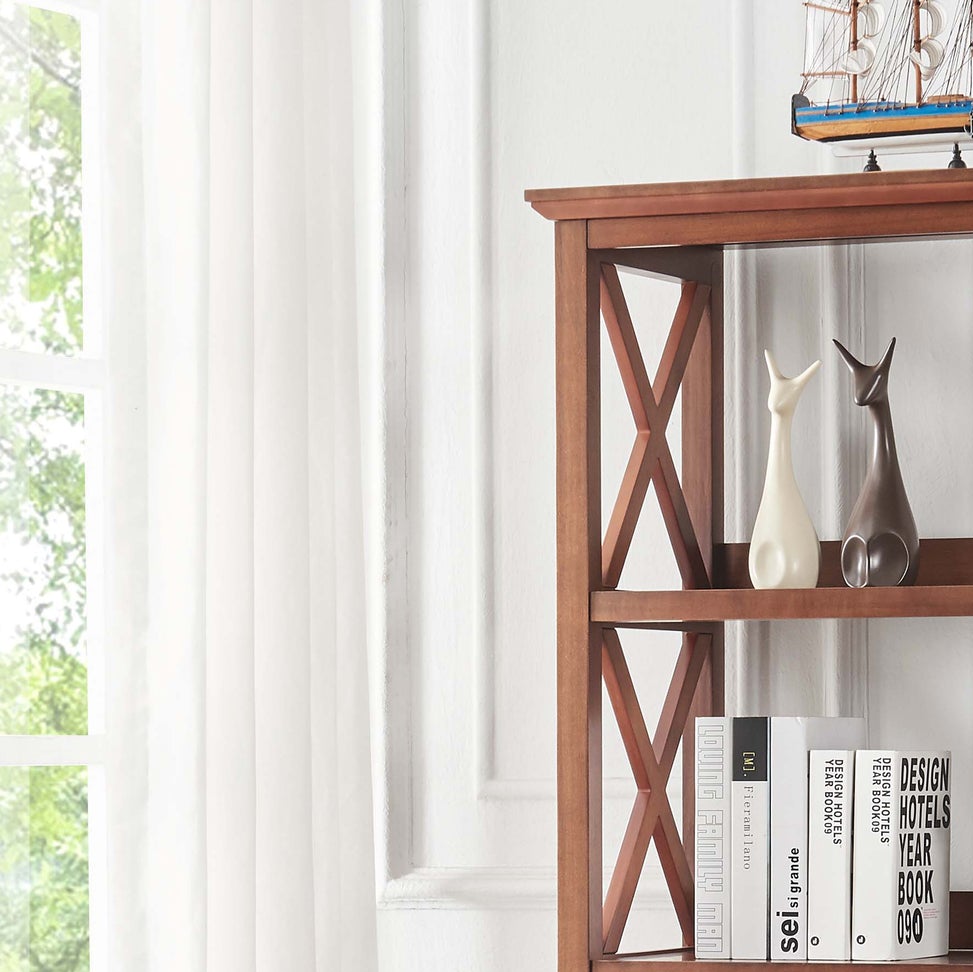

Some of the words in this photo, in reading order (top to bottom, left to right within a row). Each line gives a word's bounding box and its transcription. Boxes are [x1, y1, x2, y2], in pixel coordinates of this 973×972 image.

[824, 759, 834, 787] YEAR
[834, 759, 844, 799] DESIGN
[872, 757, 882, 786] YEAR
[881, 757, 892, 797] DESIGN
[900, 757, 949, 792] DESIGN
[743, 785, 754, 871] Fieramilano
[833, 803, 843, 845] HOTELS
[880, 801, 891, 844] HOTELS
[899, 794, 950, 830] HOTELS
[697, 809, 724, 893] FAMILY
[898, 832, 932, 868] YEAR
[897, 869, 934, 906] BOOK
[696, 902, 723, 953] MAN
[776, 911, 799, 953] sei
